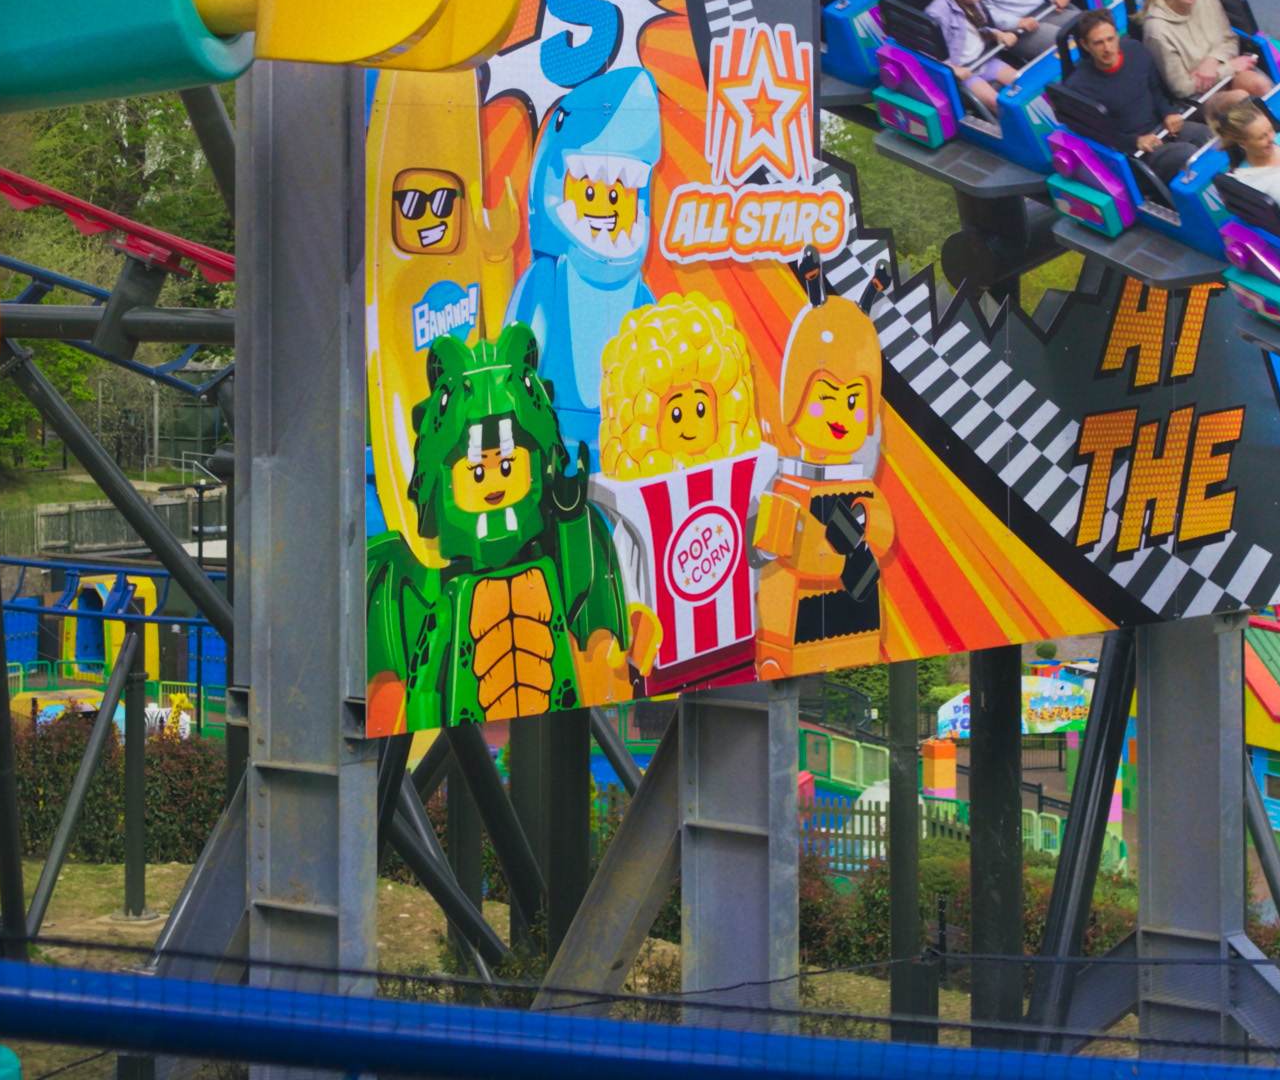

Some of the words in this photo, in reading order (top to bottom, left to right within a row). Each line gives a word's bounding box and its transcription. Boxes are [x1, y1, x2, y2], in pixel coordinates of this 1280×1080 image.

[671, 200, 730, 247] ALL
[735, 201, 841, 247] STARS
[413, 285, 478, 349] BANANA!
[1100, 274, 1226, 388] AT
[1076, 406, 1245, 553] THE
[677, 527, 713, 574] POP
[691, 538, 731, 583] CORN
